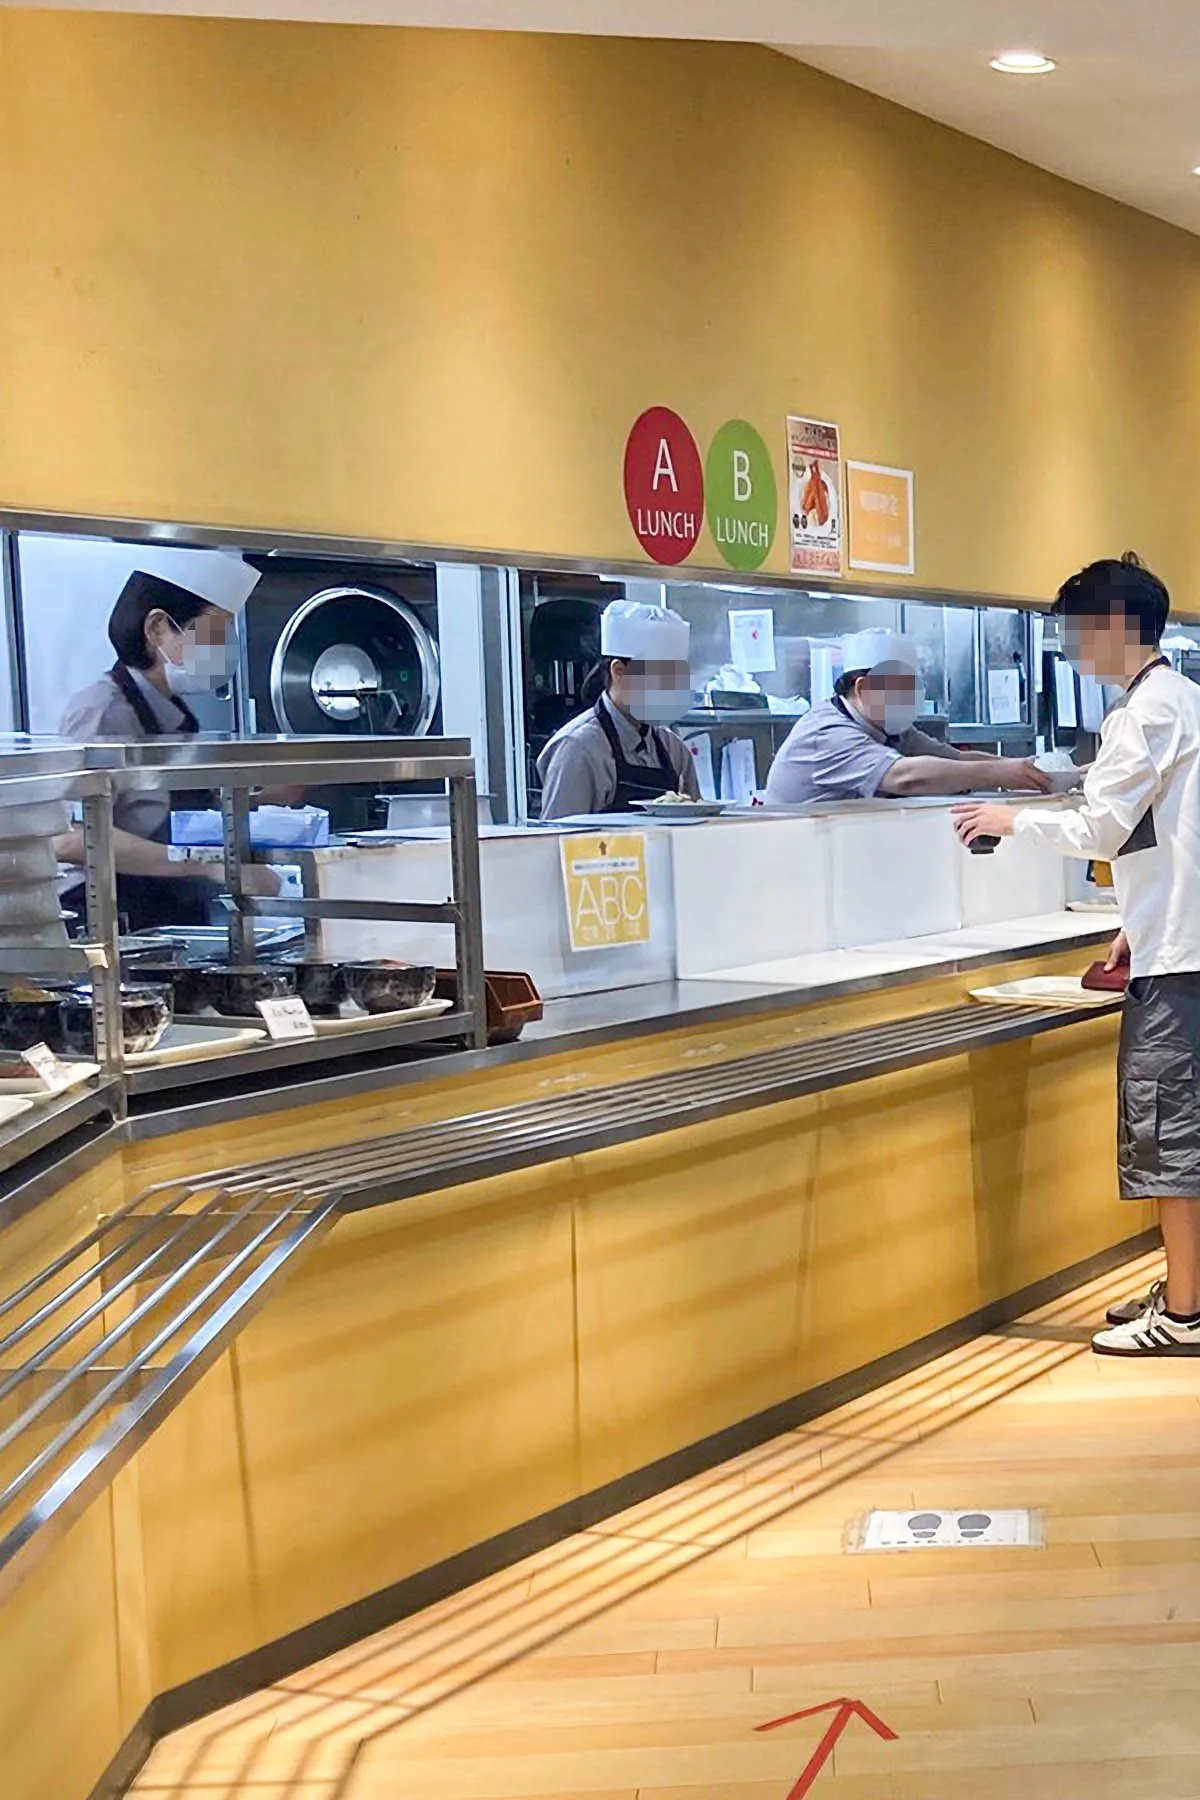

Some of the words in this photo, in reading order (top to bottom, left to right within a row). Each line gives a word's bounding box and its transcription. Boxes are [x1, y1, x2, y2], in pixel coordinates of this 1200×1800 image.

[652, 438, 679, 493] A
[733, 450, 752, 502] B
[636, 508, 695, 540] LUNCH
[716, 516, 769, 548] LUNCH
[575, 875, 644, 928] ABC
